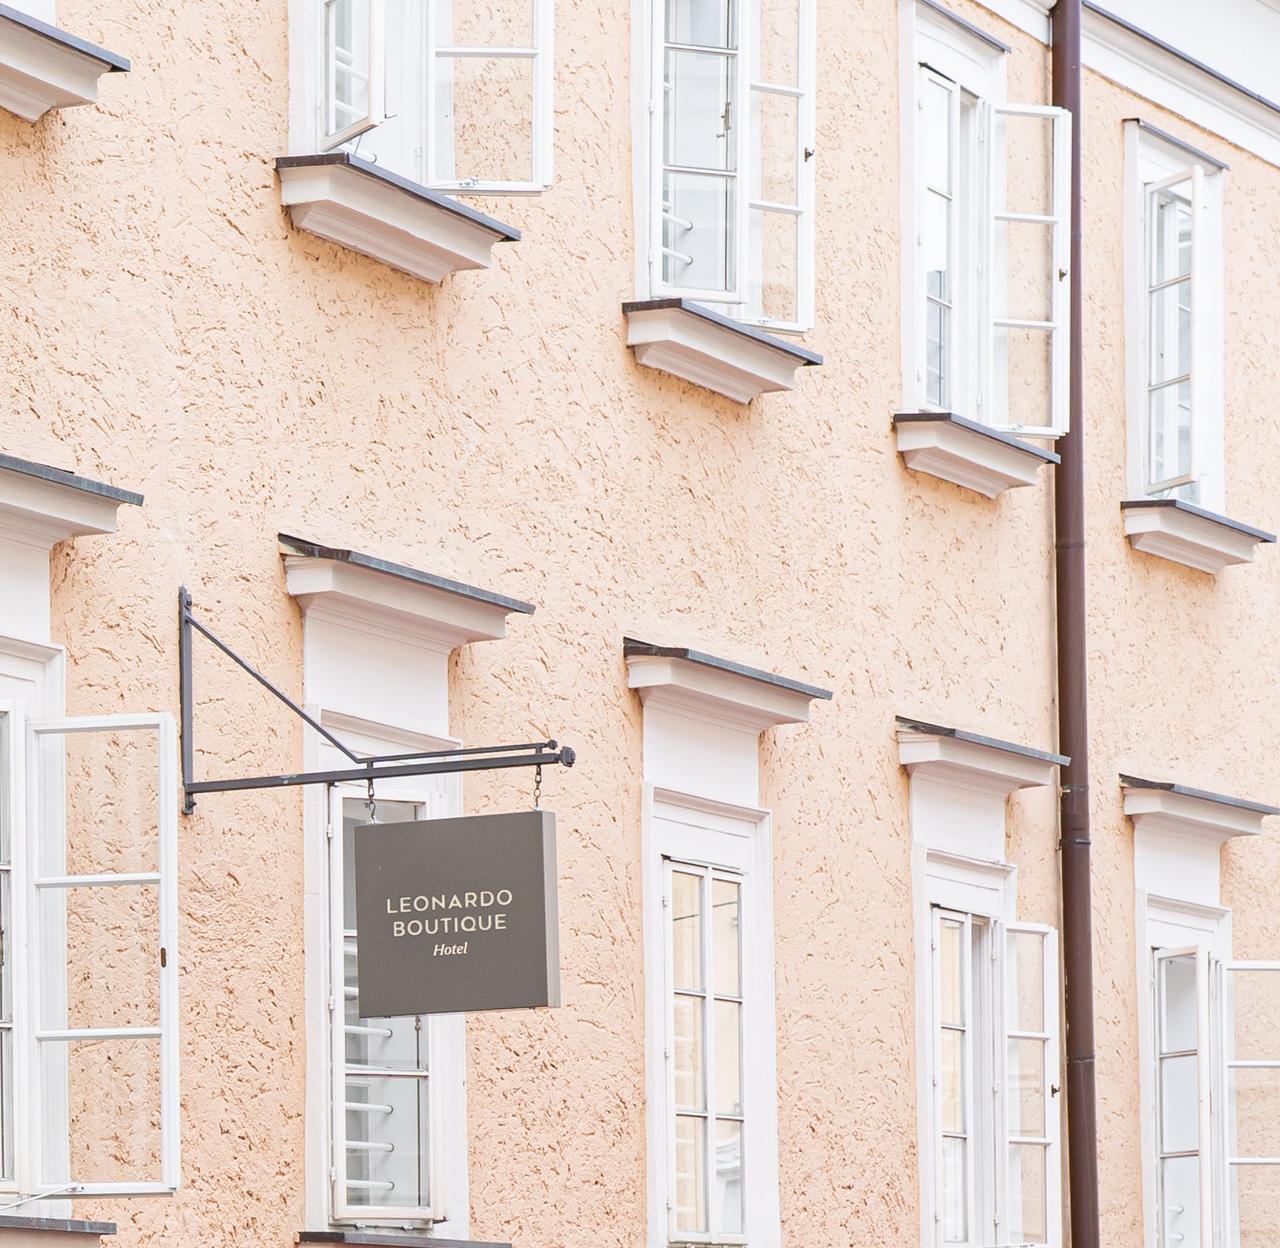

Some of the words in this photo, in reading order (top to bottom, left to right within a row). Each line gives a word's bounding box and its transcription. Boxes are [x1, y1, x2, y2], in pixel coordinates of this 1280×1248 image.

[386, 889, 513, 914] LEONARDO
[393, 914, 507, 937] BOUTIQUE
[433, 942, 468, 956] Hotel
